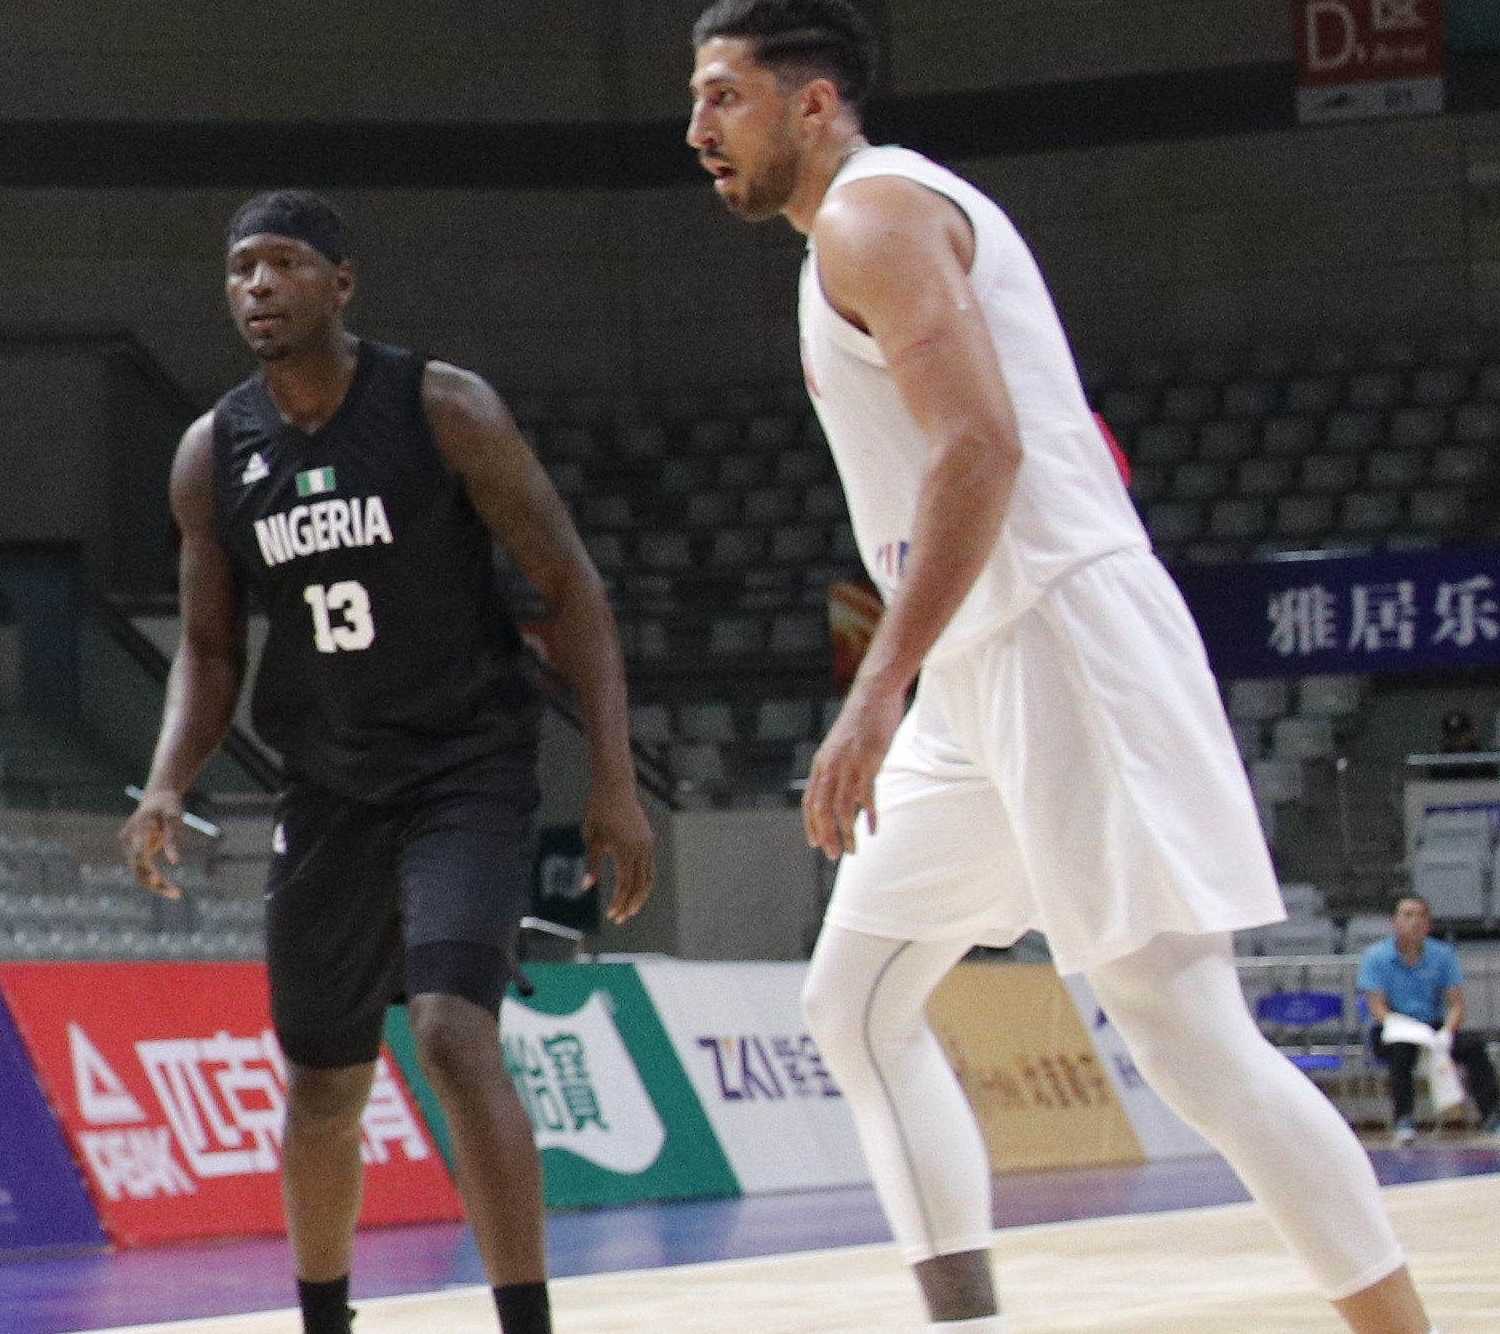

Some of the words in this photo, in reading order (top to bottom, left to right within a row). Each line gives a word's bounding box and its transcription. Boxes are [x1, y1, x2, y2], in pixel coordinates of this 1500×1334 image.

[254, 495, 394, 567] NIGERIA
[303, 579, 375, 654] 13
[696, 1034, 786, 1102] ZKI
[75, 1124, 197, 1203] PEAK
